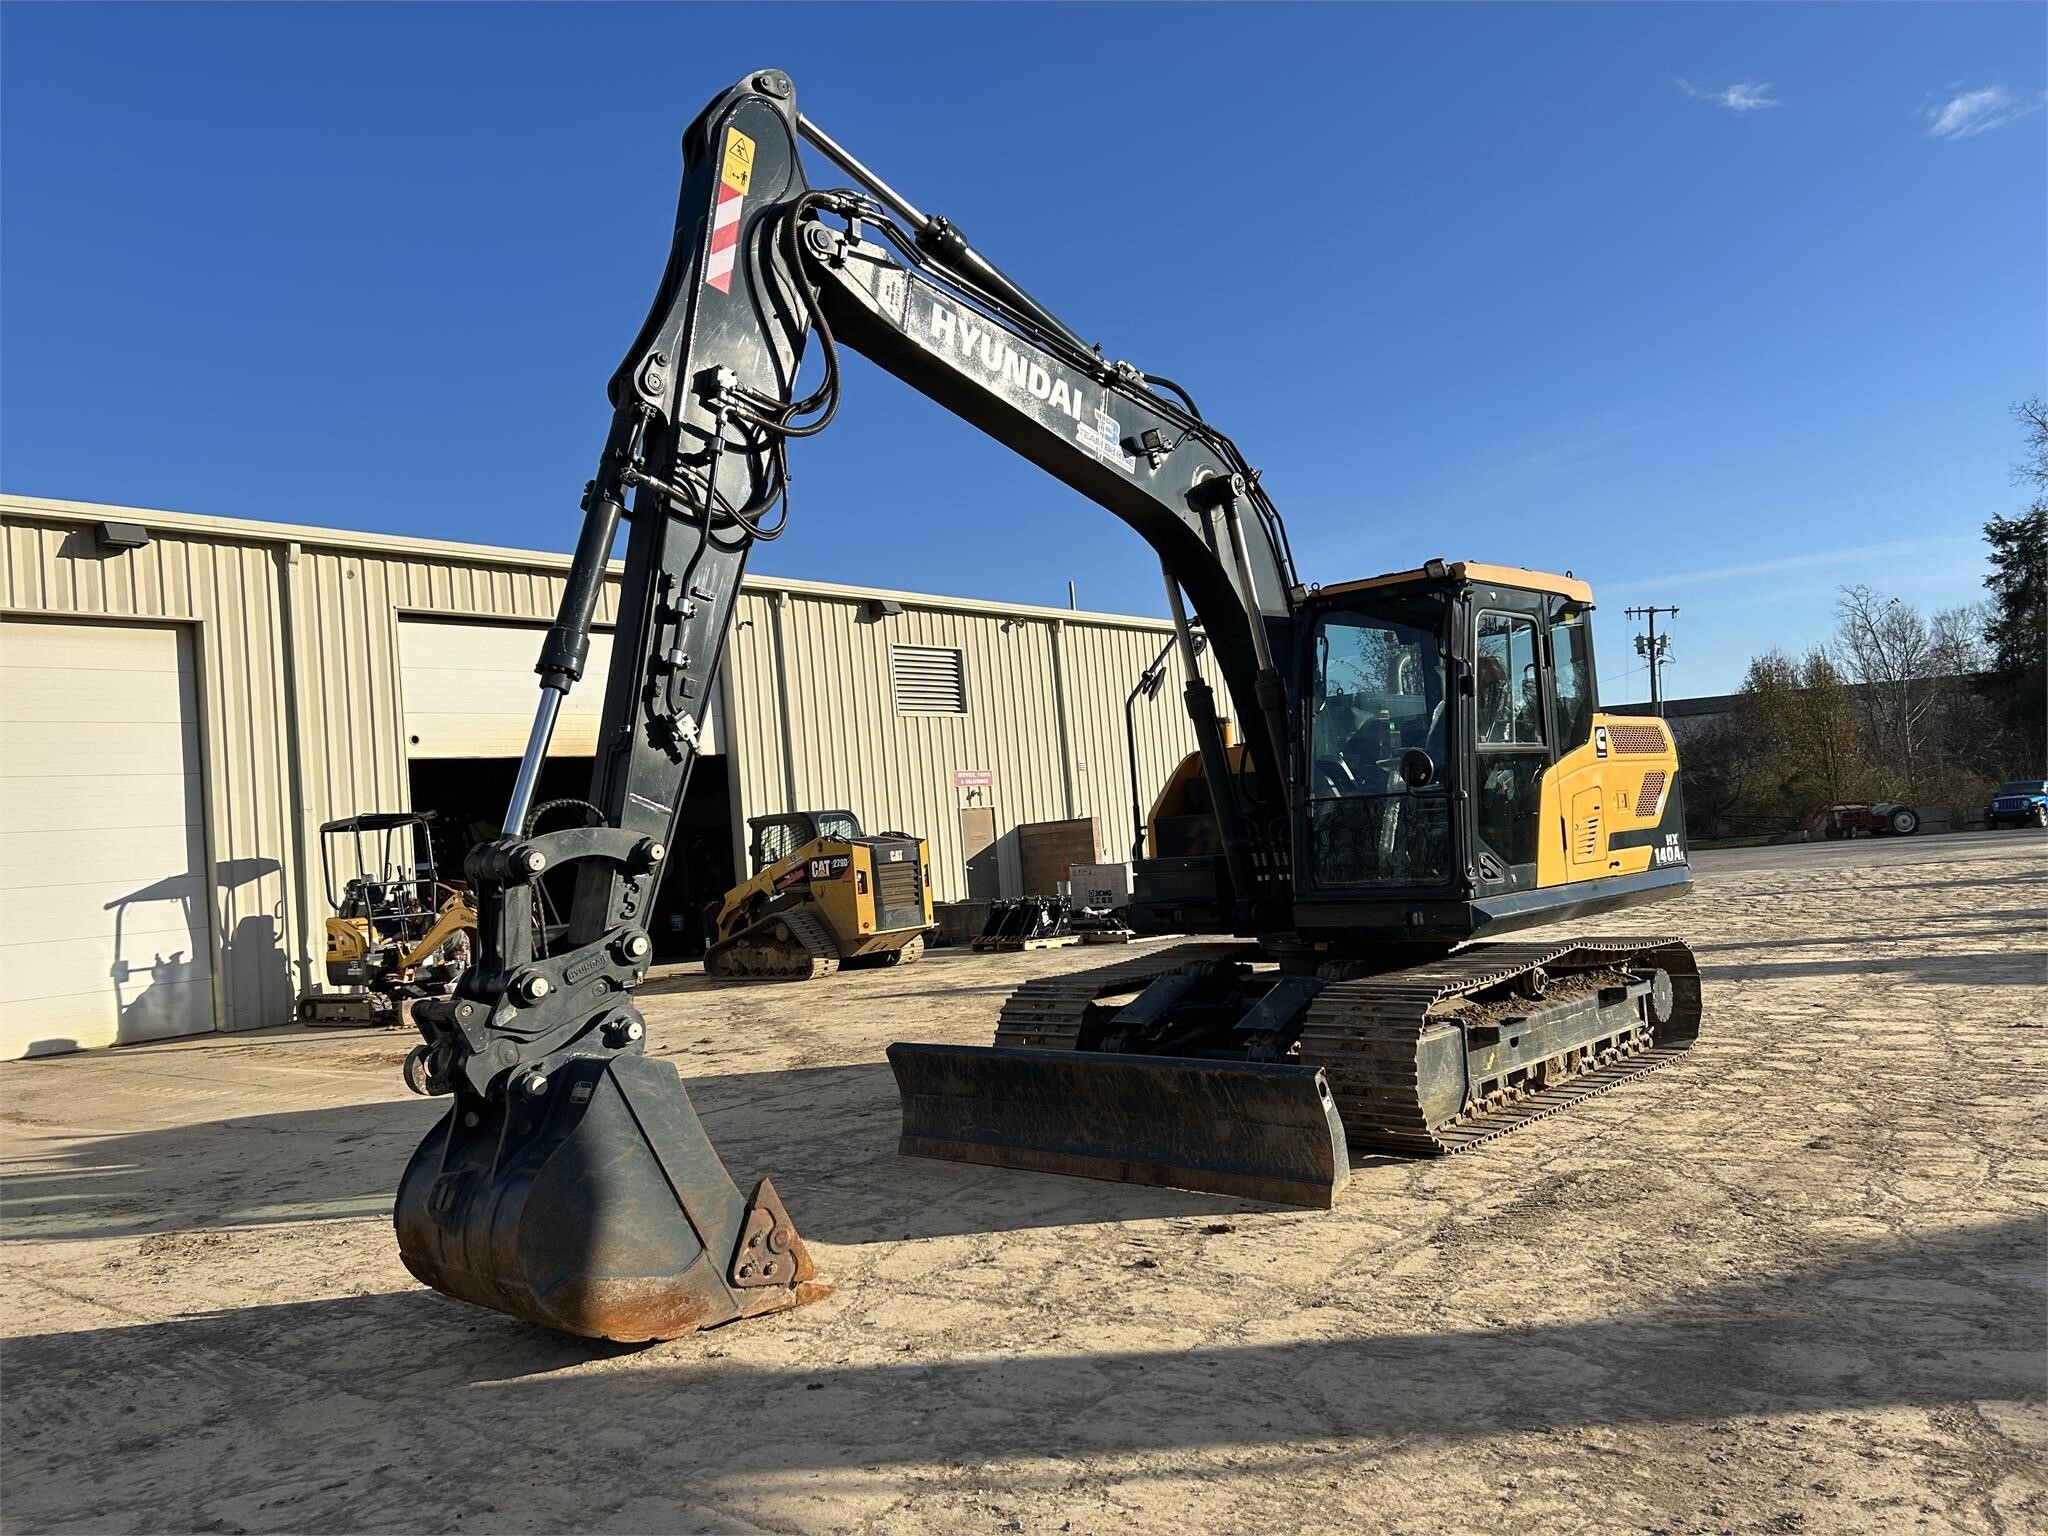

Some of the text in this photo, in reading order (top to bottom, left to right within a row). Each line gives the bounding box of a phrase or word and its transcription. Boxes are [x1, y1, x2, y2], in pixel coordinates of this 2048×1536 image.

[930, 302, 1083, 421] HYUNDAI
[1665, 833, 1679, 846] HX
[890, 850, 904, 862] CAT
[811, 859, 831, 878] CAT
[459, 913, 478, 925] SHANT
